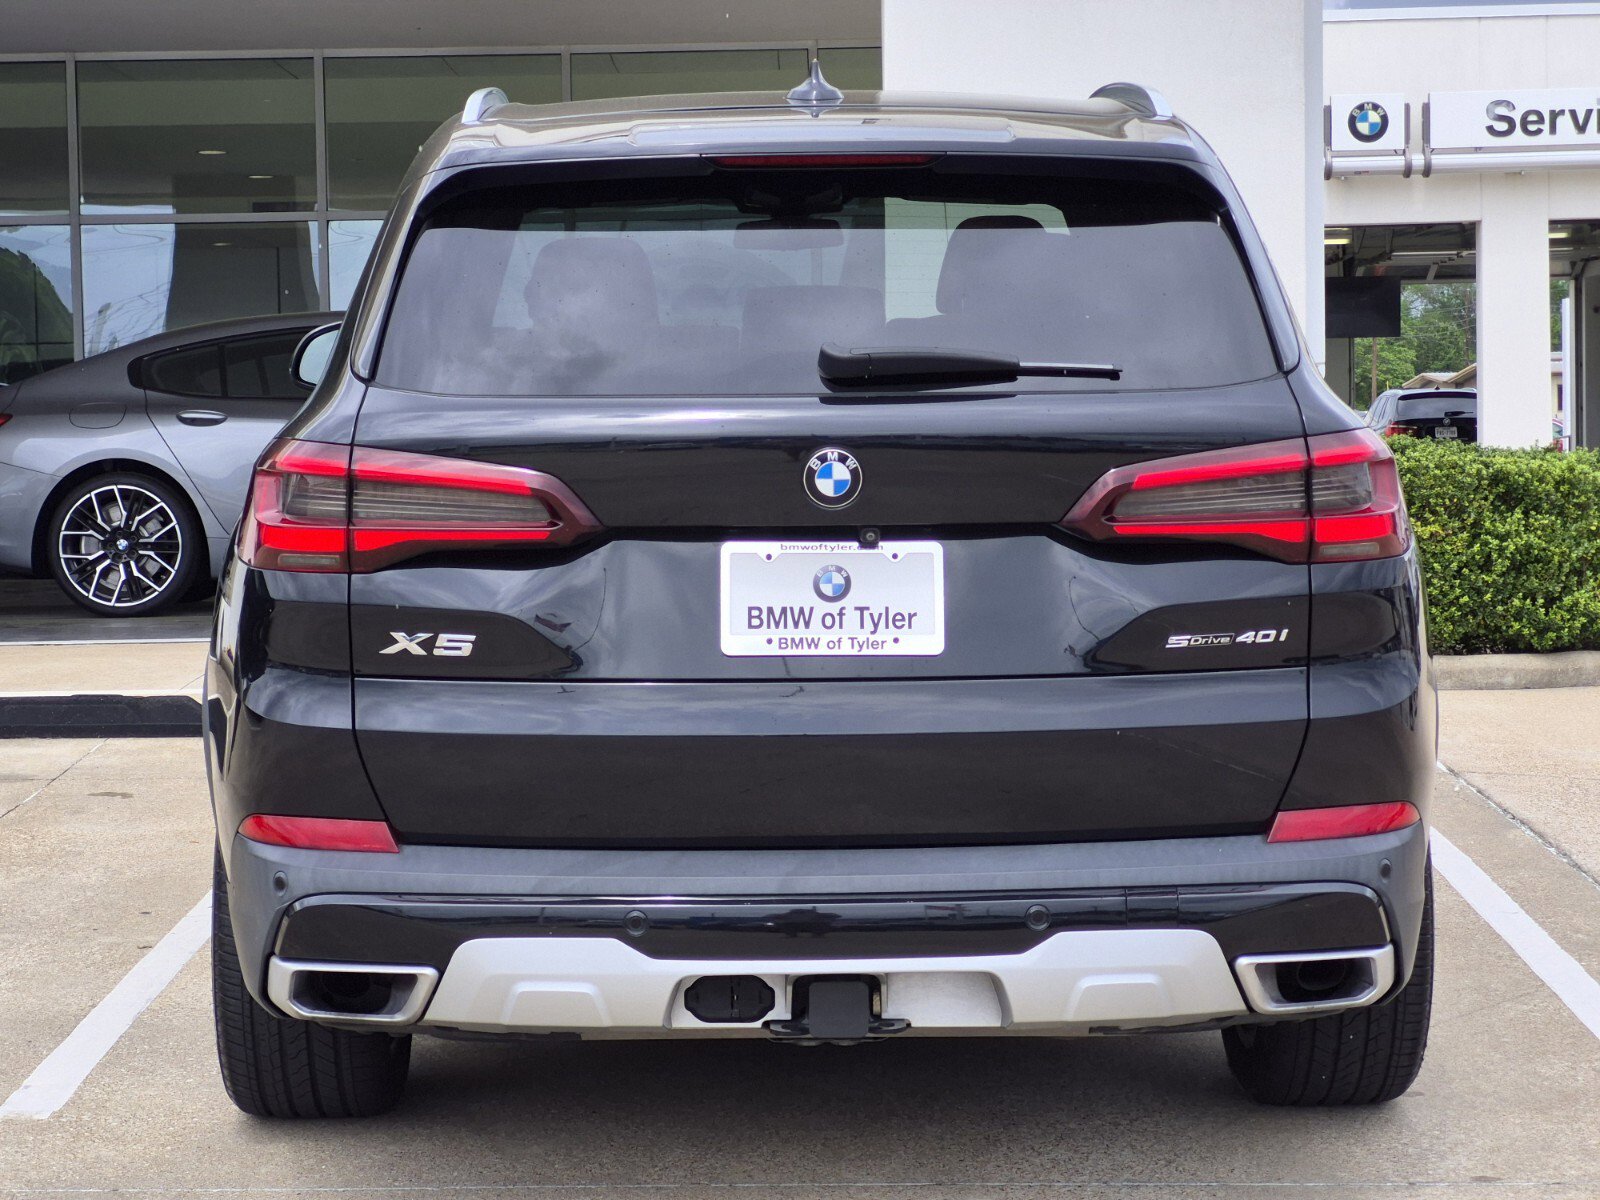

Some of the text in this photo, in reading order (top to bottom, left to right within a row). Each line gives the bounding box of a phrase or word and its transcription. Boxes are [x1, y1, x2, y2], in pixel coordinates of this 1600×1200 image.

[1351, 103, 1385, 116] BMW
[809, 451, 857, 470] BMW
[780, 543, 884, 552] bmwoftyler.
[816, 565, 848, 577] BMW
[747, 606, 917, 634] BMW of Tyler
[379, 632, 476, 656] X5
[778, 637, 887, 652] BMW of Tyler
